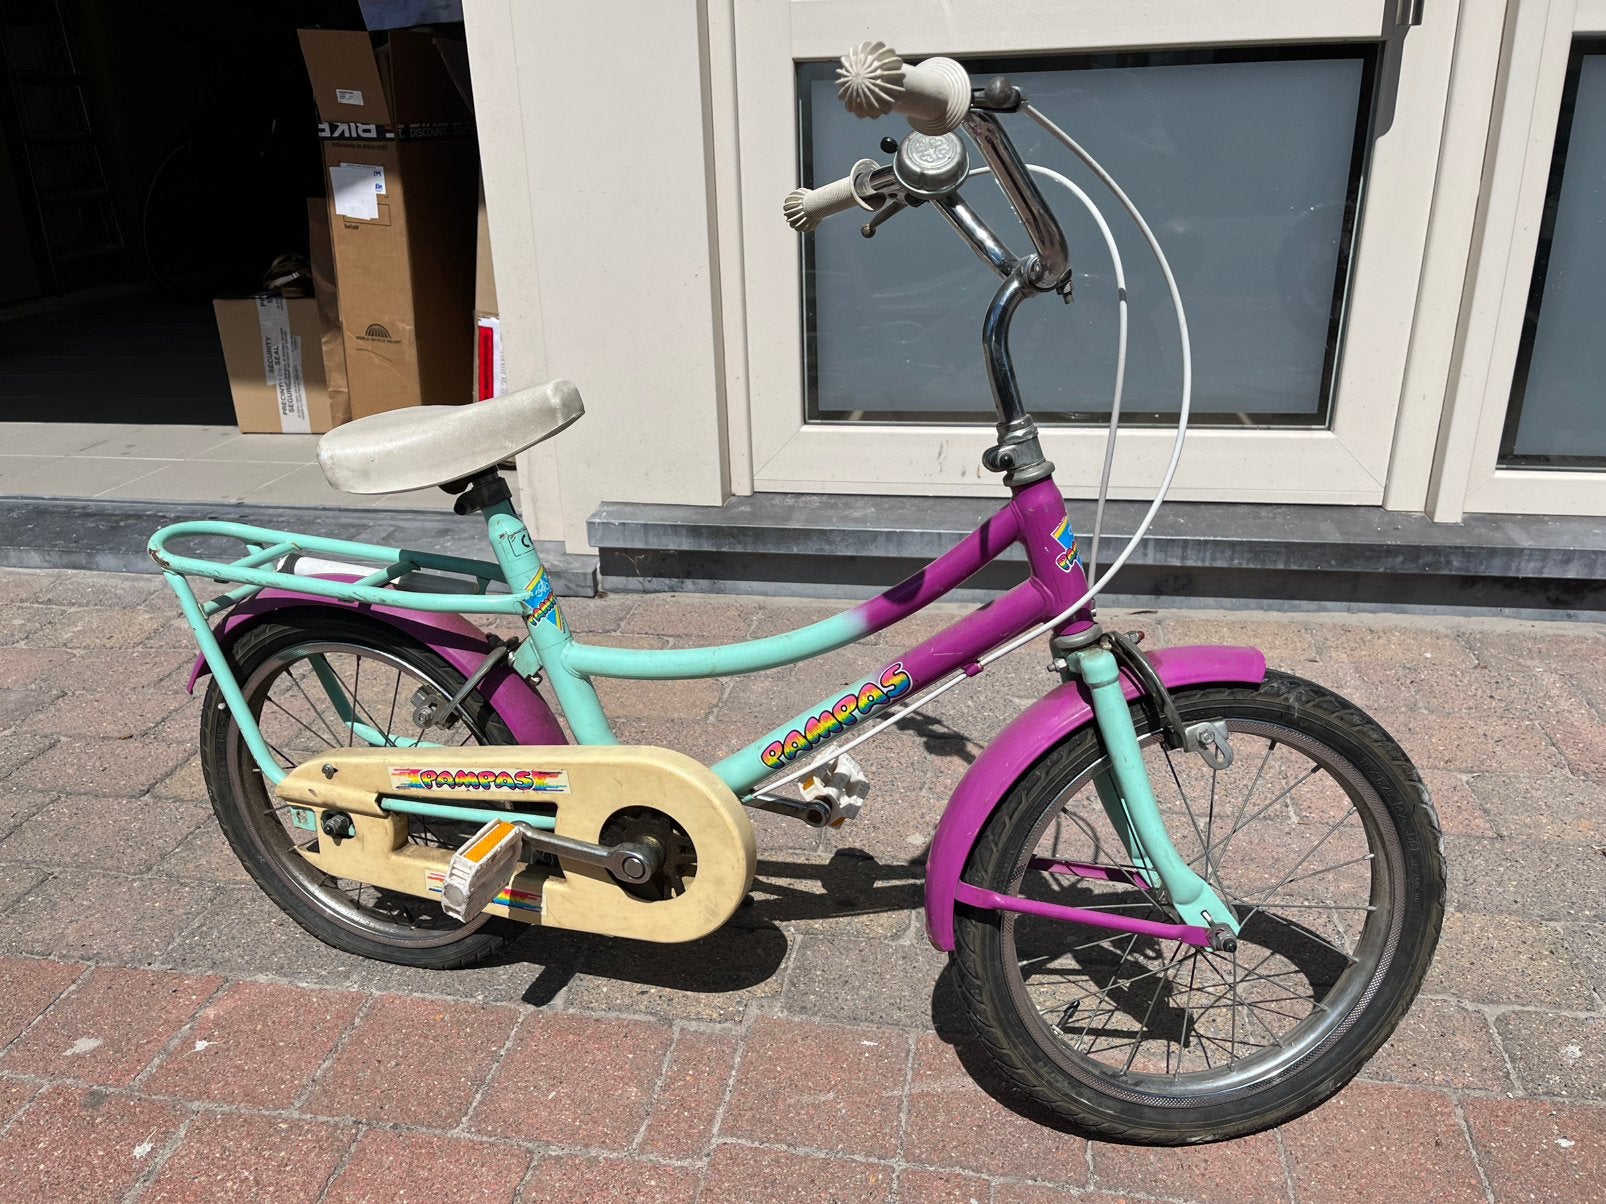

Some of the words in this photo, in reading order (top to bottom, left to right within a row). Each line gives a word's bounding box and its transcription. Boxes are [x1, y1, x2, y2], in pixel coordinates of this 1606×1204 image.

[265, 336, 274, 374] SECURITY
[273, 345, 281, 366] SEAL
[761, 661, 911, 770] PAMPAS
[419, 769, 535, 791] PAMPAS
